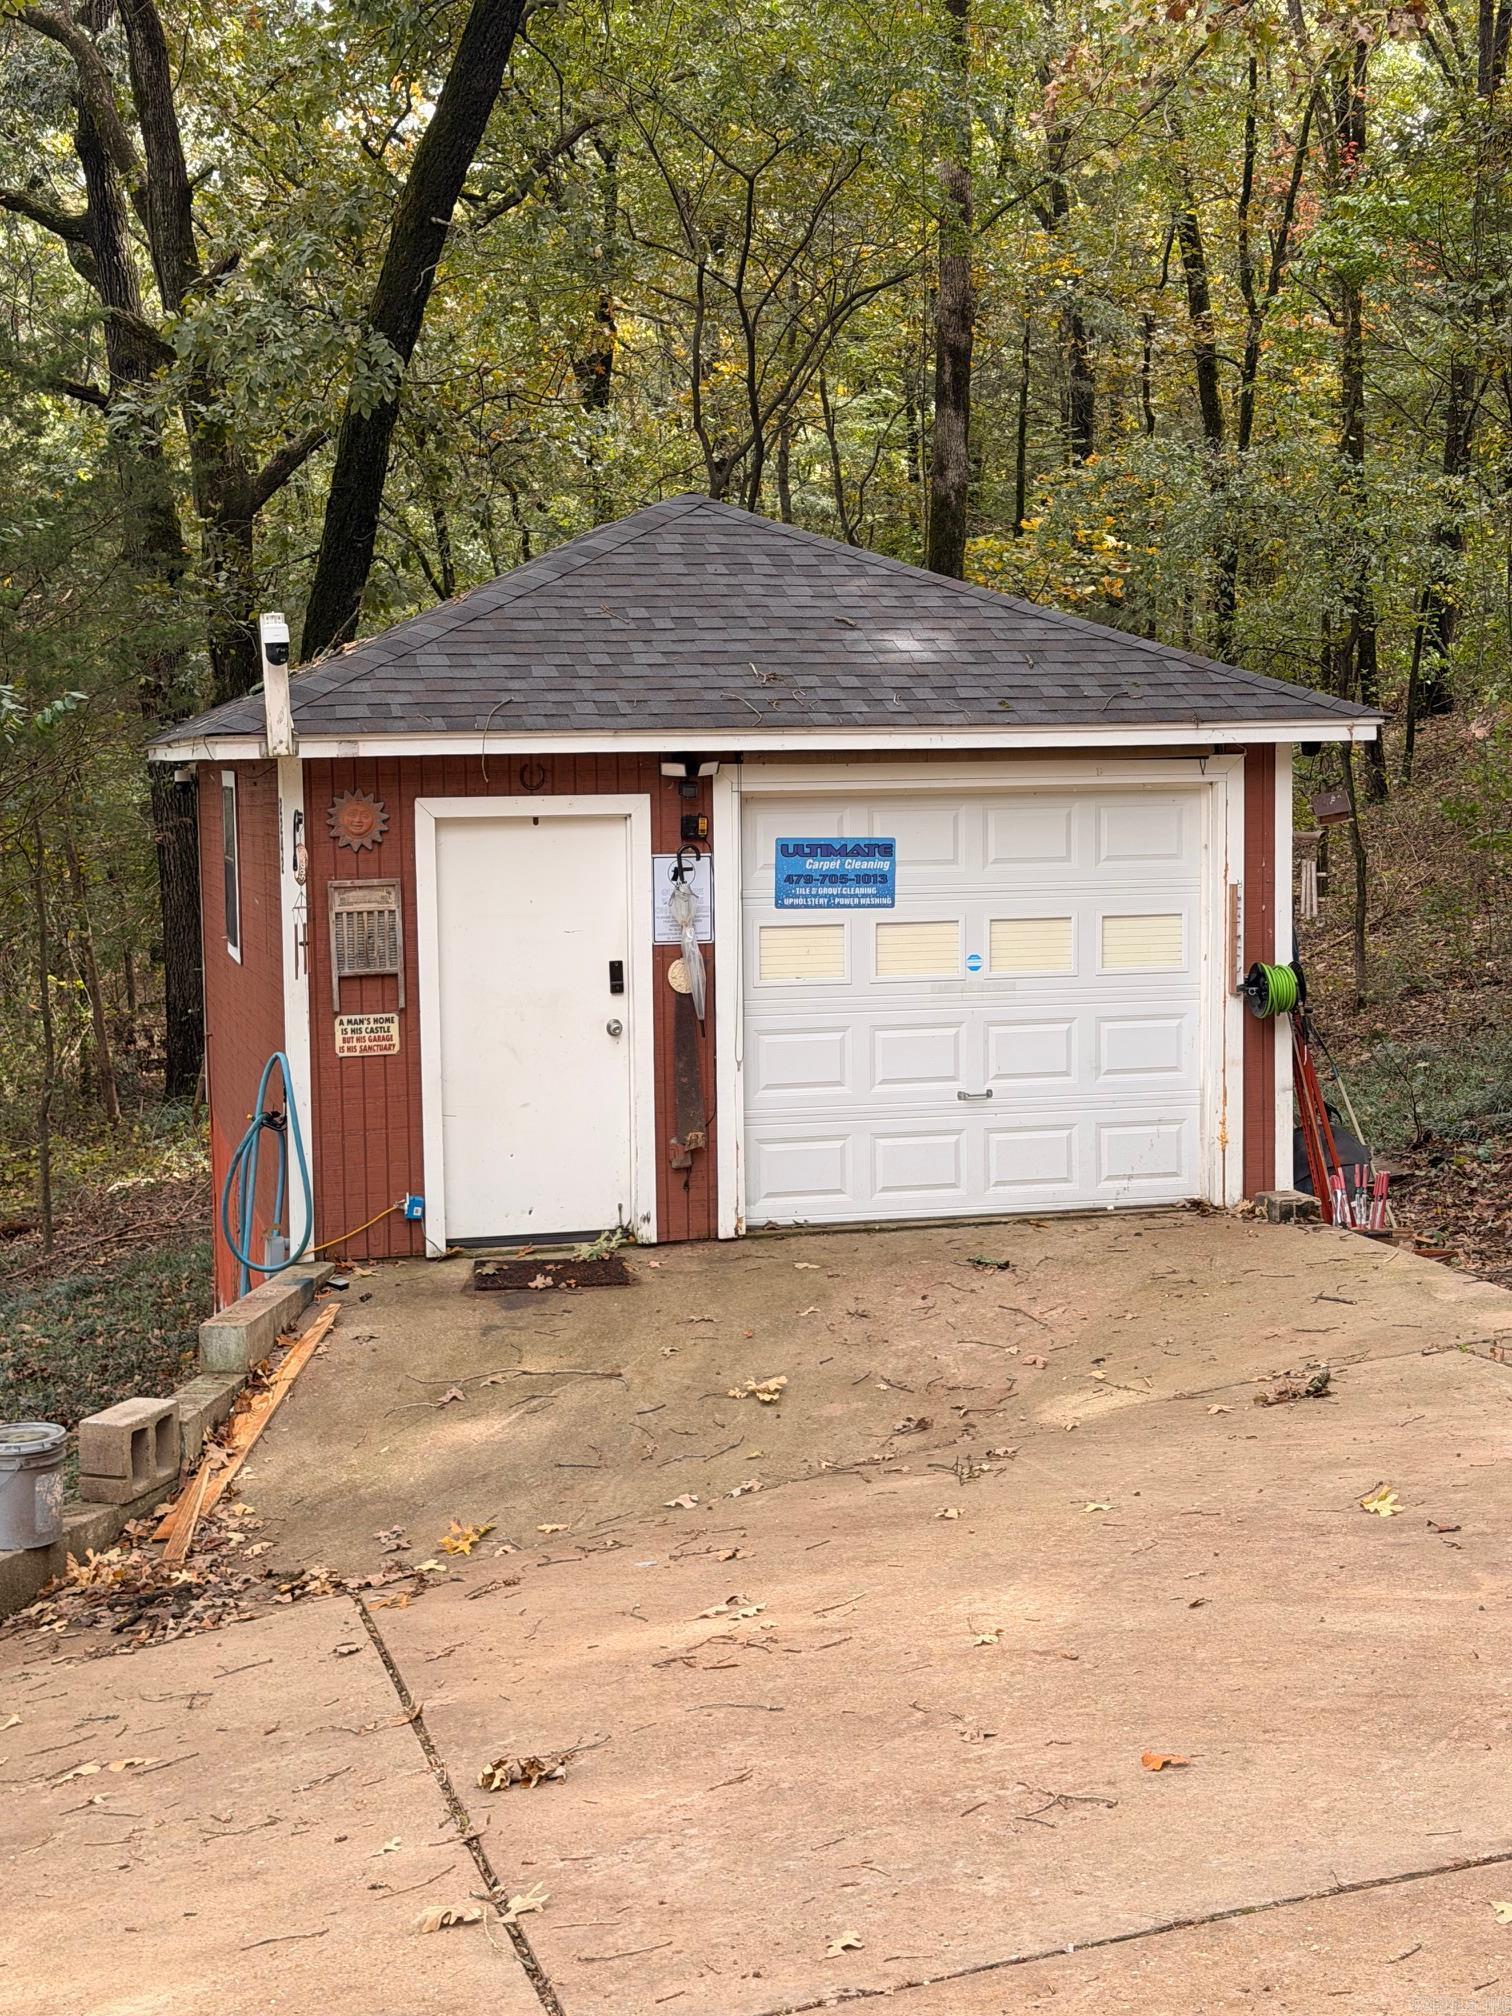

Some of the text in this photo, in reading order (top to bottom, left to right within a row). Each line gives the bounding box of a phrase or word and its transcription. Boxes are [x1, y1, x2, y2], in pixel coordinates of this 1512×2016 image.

[781, 843, 894, 858] ULTIMATE
[806, 859, 890, 871] Carpet Cleaning
[784, 874, 888, 884] 479-705-1013
[346, 1017, 371, 1026] MAN'S
[350, 1027, 363, 1035] HIS
[364, 1026, 391, 1034] CASTLE
[342, 1034, 394, 1044] BUT HIS GARAGE
[358, 1044, 396, 1054] SANCTUARY
